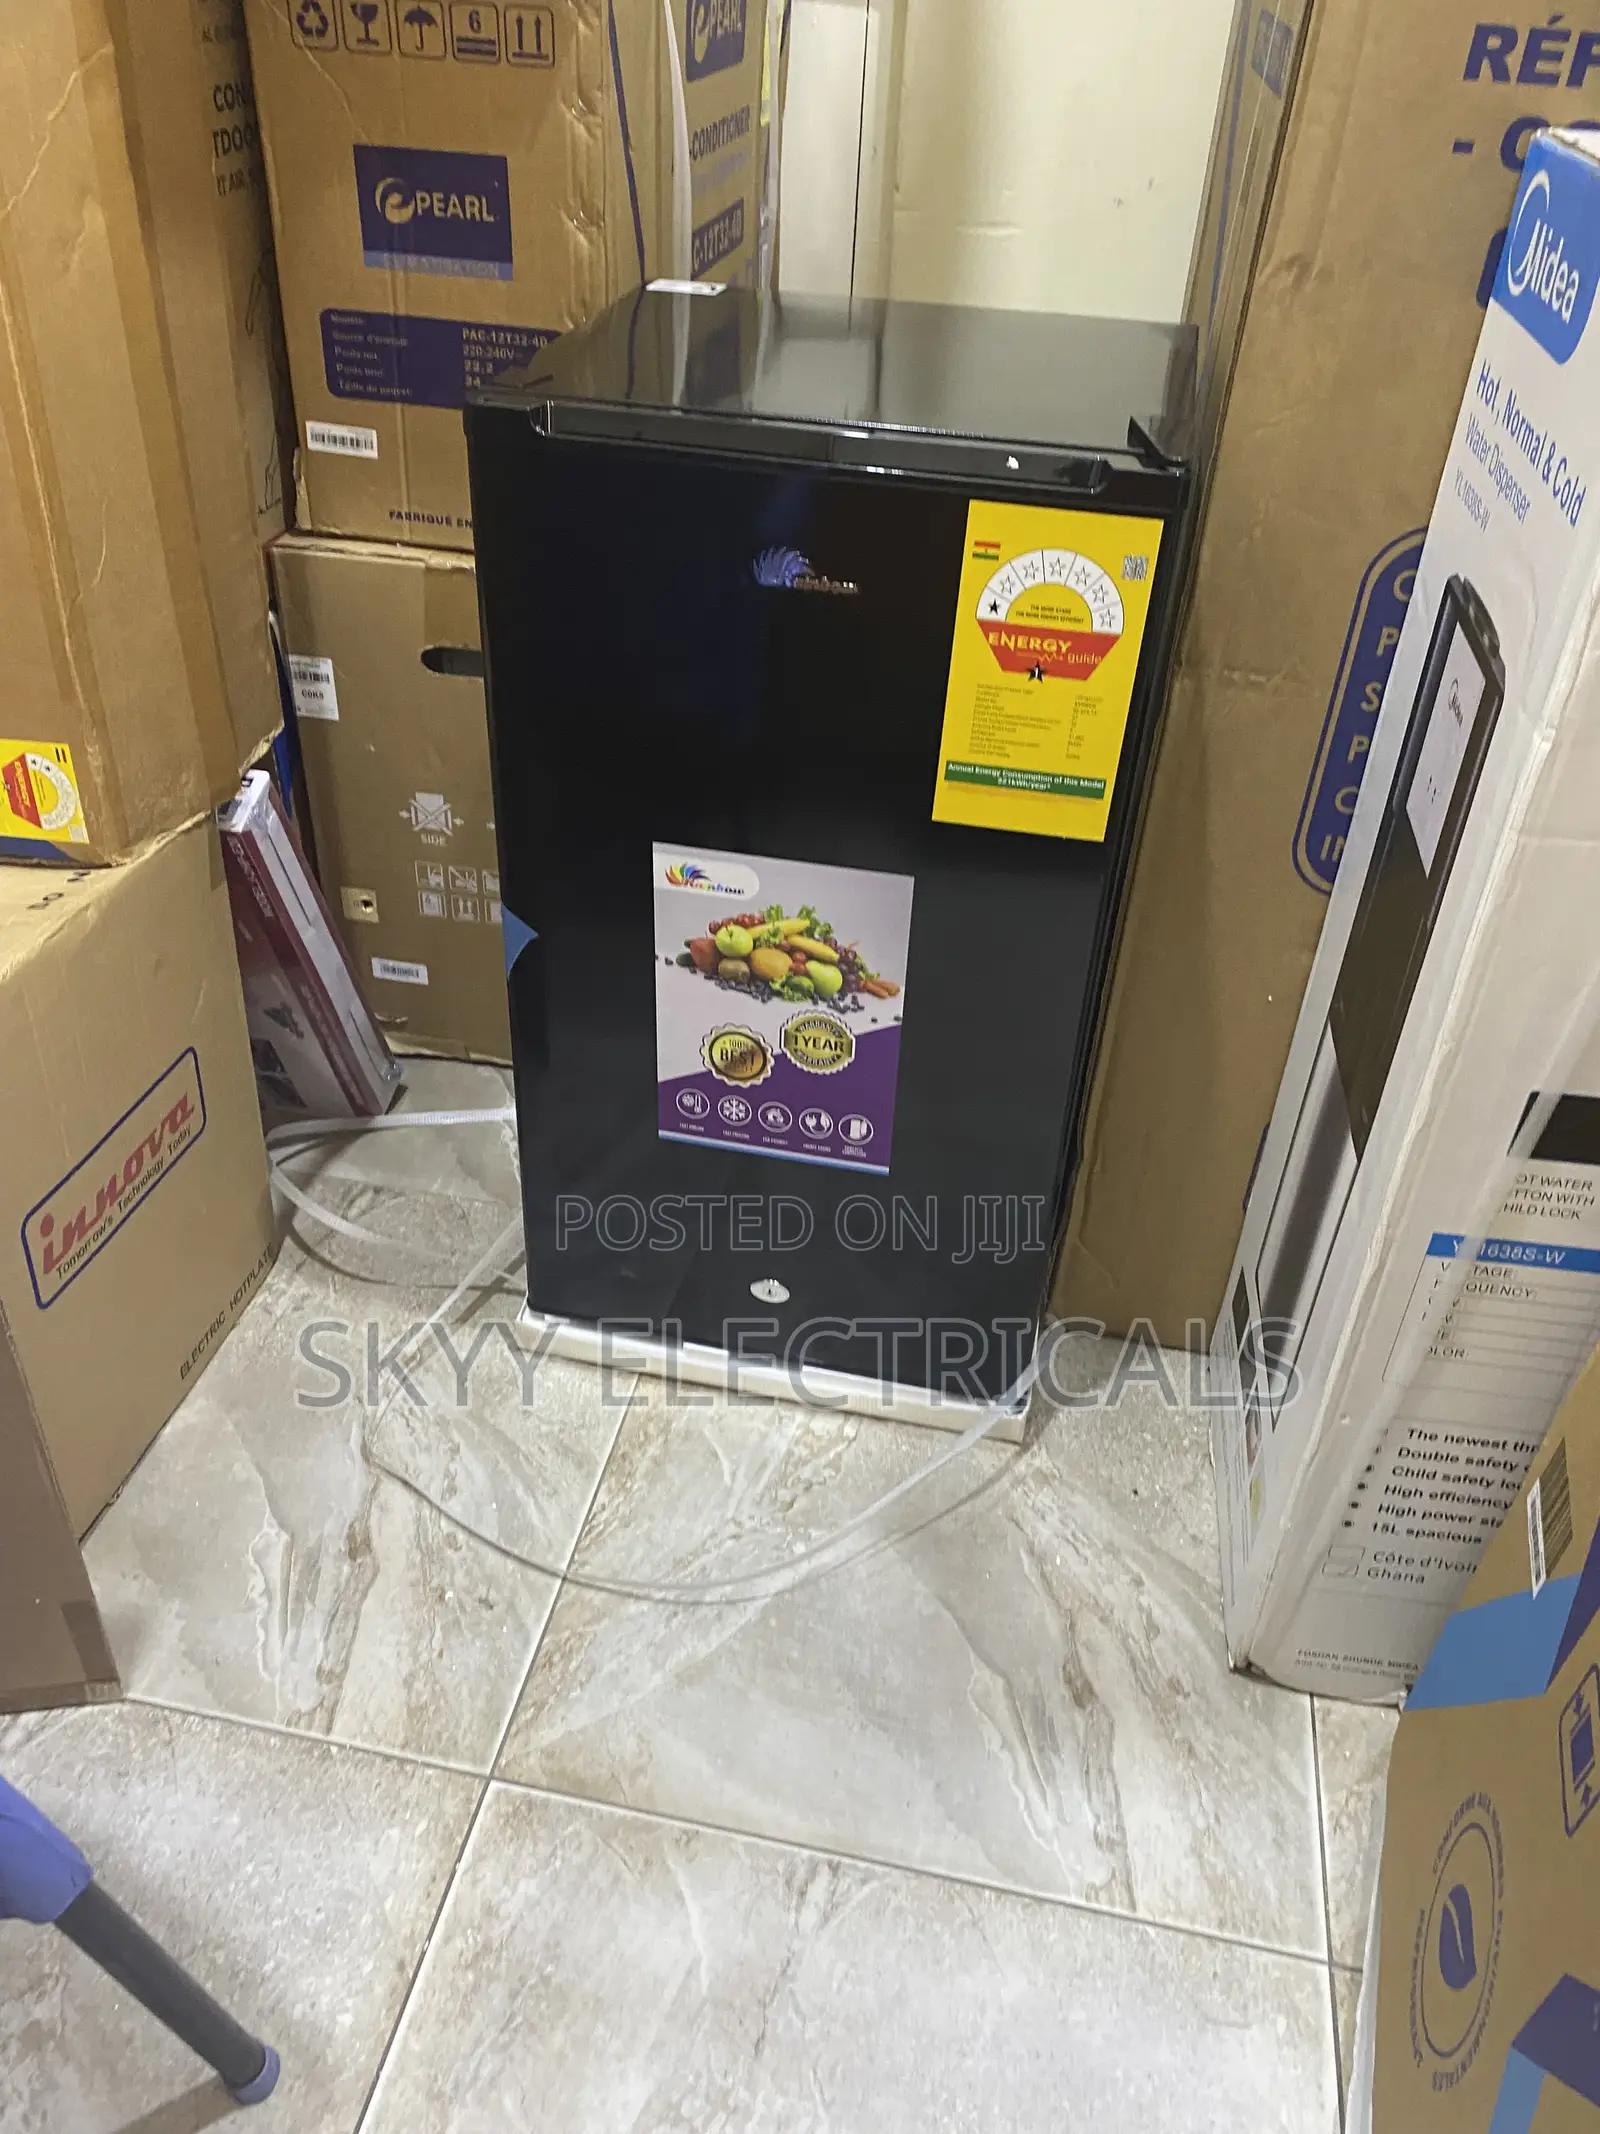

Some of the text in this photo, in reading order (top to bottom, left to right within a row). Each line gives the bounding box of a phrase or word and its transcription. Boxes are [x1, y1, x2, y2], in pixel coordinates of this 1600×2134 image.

[415, 190, 495, 222] PEARL
[1508, 169, 1580, 324] Midea
[1465, 412, 1531, 526] Water Dispenser
[1502, 388, 1548, 472] Normal
[1542, 440, 1556, 486] &
[1552, 456, 1587, 529] Cold
[988, 630, 1072, 652] ENERGY
[948, 763, 974, 774] Annual
[975, 766, 1001, 778] Energy
[1079, 778, 1104, 790] Model
[421, 833, 447, 847] SIDE
[801, 1034, 844, 1053] YEAR
[1540, 1176, 1593, 1191] WATER
[56, 1124, 192, 1280] Tomorrow's Technology Today
[1503, 1202, 1580, 1220] HILD LOCK
[1556, 1192, 1595, 1207] WITH
[180, 1241, 273, 1379] ELECTRIC HOTPLATE
[1407, 1428, 1438, 1441] The
[1444, 1434, 1508, 1450] newest
[1398, 1447, 1460, 1464] Double
[1464, 1455, 1519, 1473] safety
[1392, 1465, 1438, 1481] Child
[1441, 1473, 1495, 1490] safety
[1384, 1484, 1513, 1510] High efficiency
[1377, 1503, 1417, 1519] High
[1421, 1510, 1475, 1526] power
[1406, 1528, 1483, 1545] spacious
[1373, 1551, 1415, 1566] Côte
[1367, 1567, 1425, 1584] Ghana
